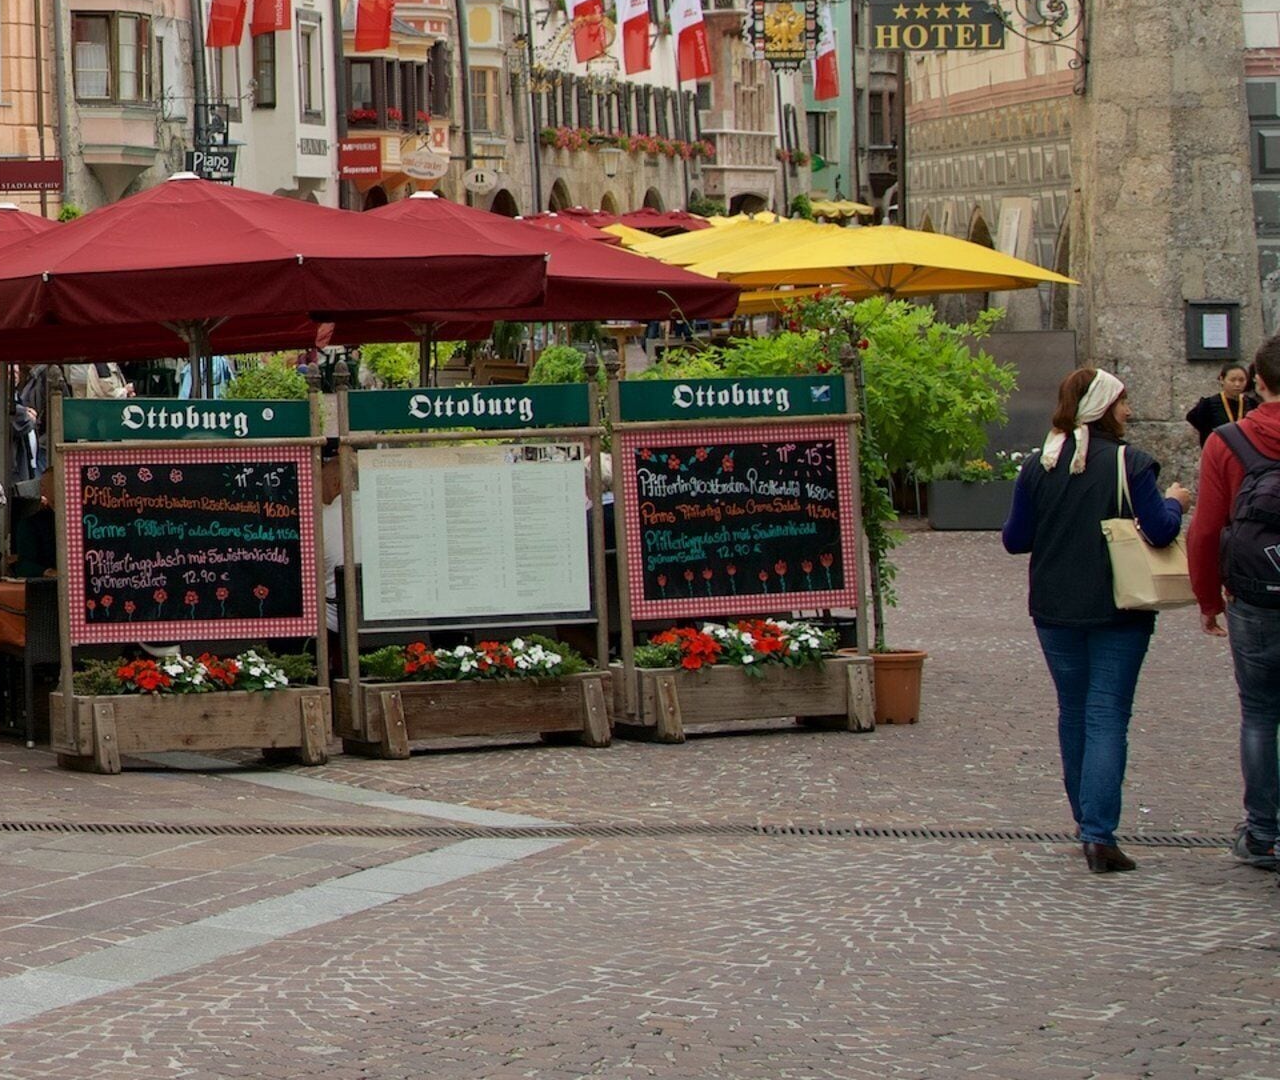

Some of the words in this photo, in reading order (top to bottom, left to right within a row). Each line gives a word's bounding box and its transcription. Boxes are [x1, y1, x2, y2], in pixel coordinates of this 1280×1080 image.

[874, 23, 1002, 49] HOTEL
[301, 138, 327, 156] BANK
[193, 152, 229, 171] Piano
[408, 392, 534, 422] Ottoburg
[672, 383, 791, 412] Ottoburg
[121, 404, 249, 437] Ottoburg
[83, 515, 126, 539] Penne
